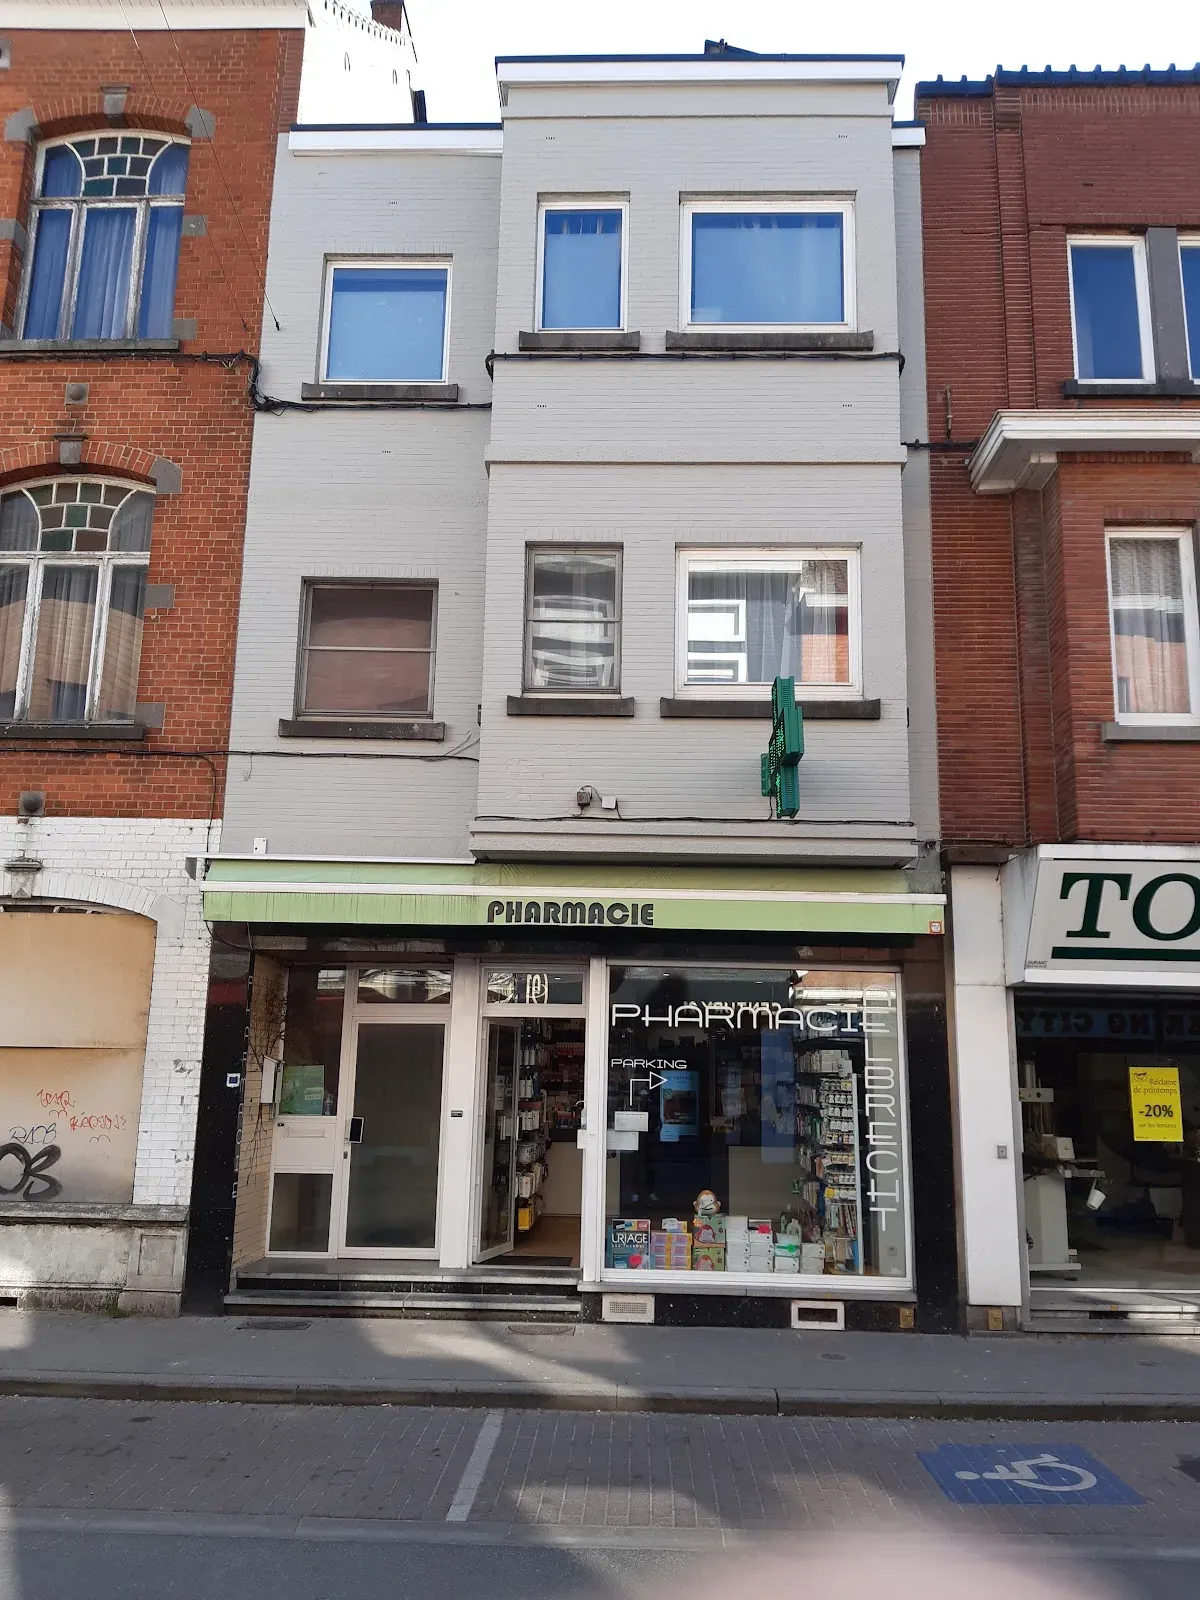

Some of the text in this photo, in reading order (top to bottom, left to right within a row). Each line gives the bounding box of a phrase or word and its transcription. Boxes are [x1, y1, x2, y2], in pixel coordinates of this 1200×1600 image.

[487, 900, 654, 926] PHARMACIE
[611, 1003, 891, 1033] PHARMACIE
[611, 1058, 688, 1070] PARKING
[1133, 1086, 1178, 1096] de printemps
[1138, 1104, 1174, 1118] -20%
[611, 1233, 648, 1246] URIAGE
